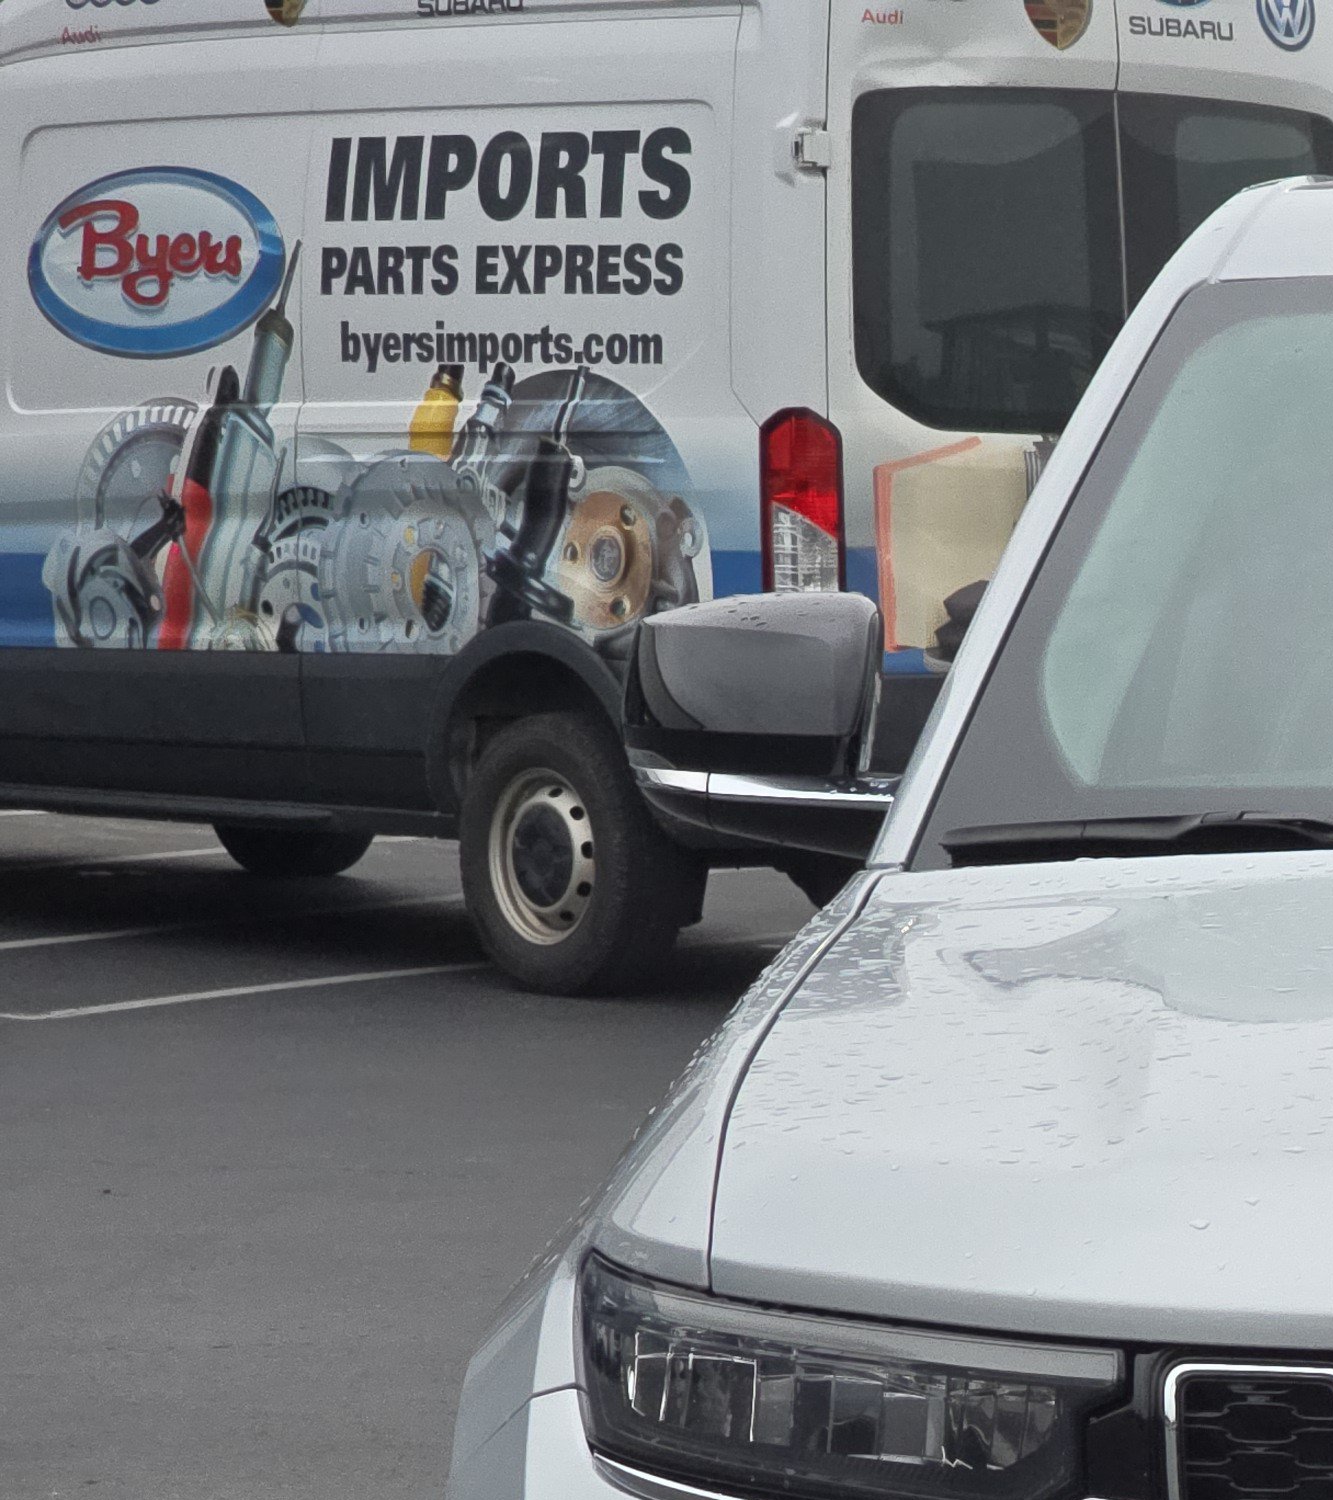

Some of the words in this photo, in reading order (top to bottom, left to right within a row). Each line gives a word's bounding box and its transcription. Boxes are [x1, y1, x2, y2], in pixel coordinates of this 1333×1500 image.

[60, 25, 101, 44] Audi
[861, 9, 904, 25] Audi
[1128, 16, 1234, 41] SUBARU
[325, 127, 692, 222] IMPORTS
[57, 200, 242, 308] Byers
[320, 245, 459, 297] PARTS
[474, 242, 684, 296] EXPRESS
[340, 321, 663, 374] byersimports.com
